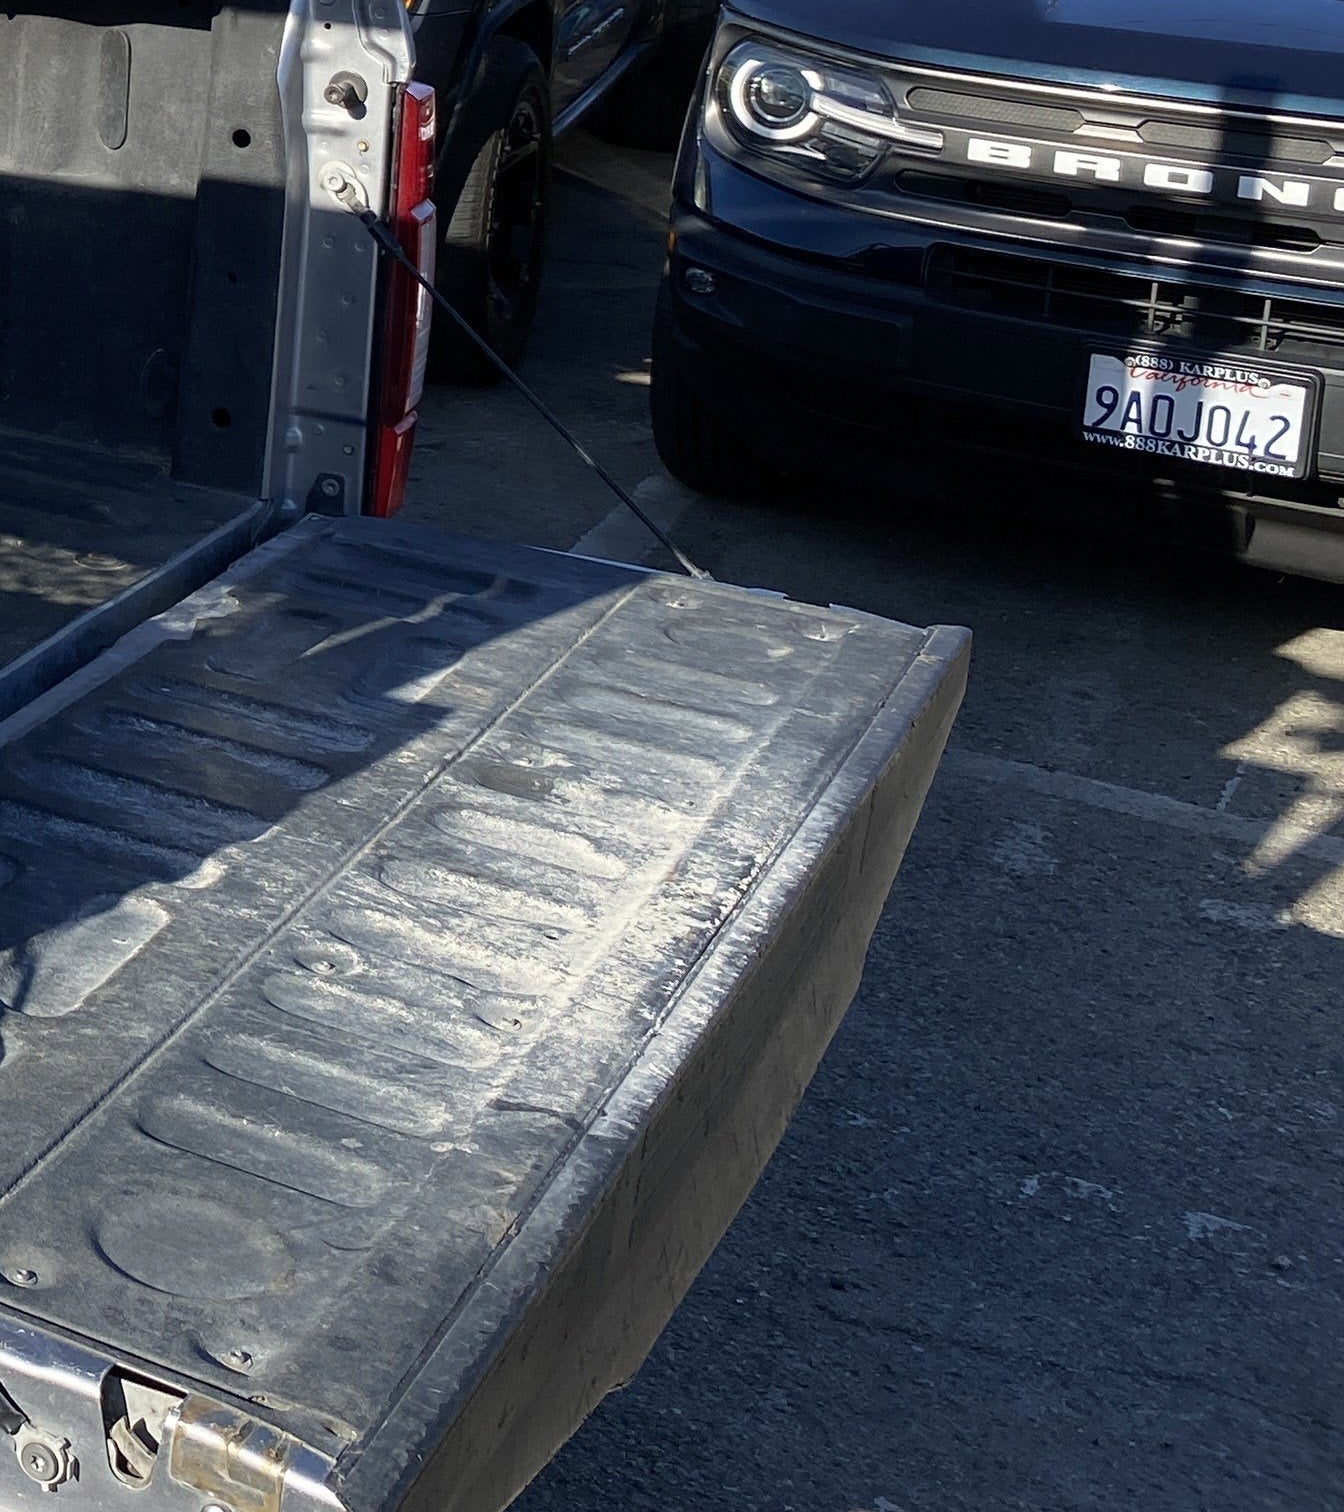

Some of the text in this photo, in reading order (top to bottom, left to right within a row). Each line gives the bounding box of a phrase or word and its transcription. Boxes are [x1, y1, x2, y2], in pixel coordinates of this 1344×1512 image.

[967, 137, 1344, 212] BRON
[1135, 354, 1260, 384] (888) KARPLUS
